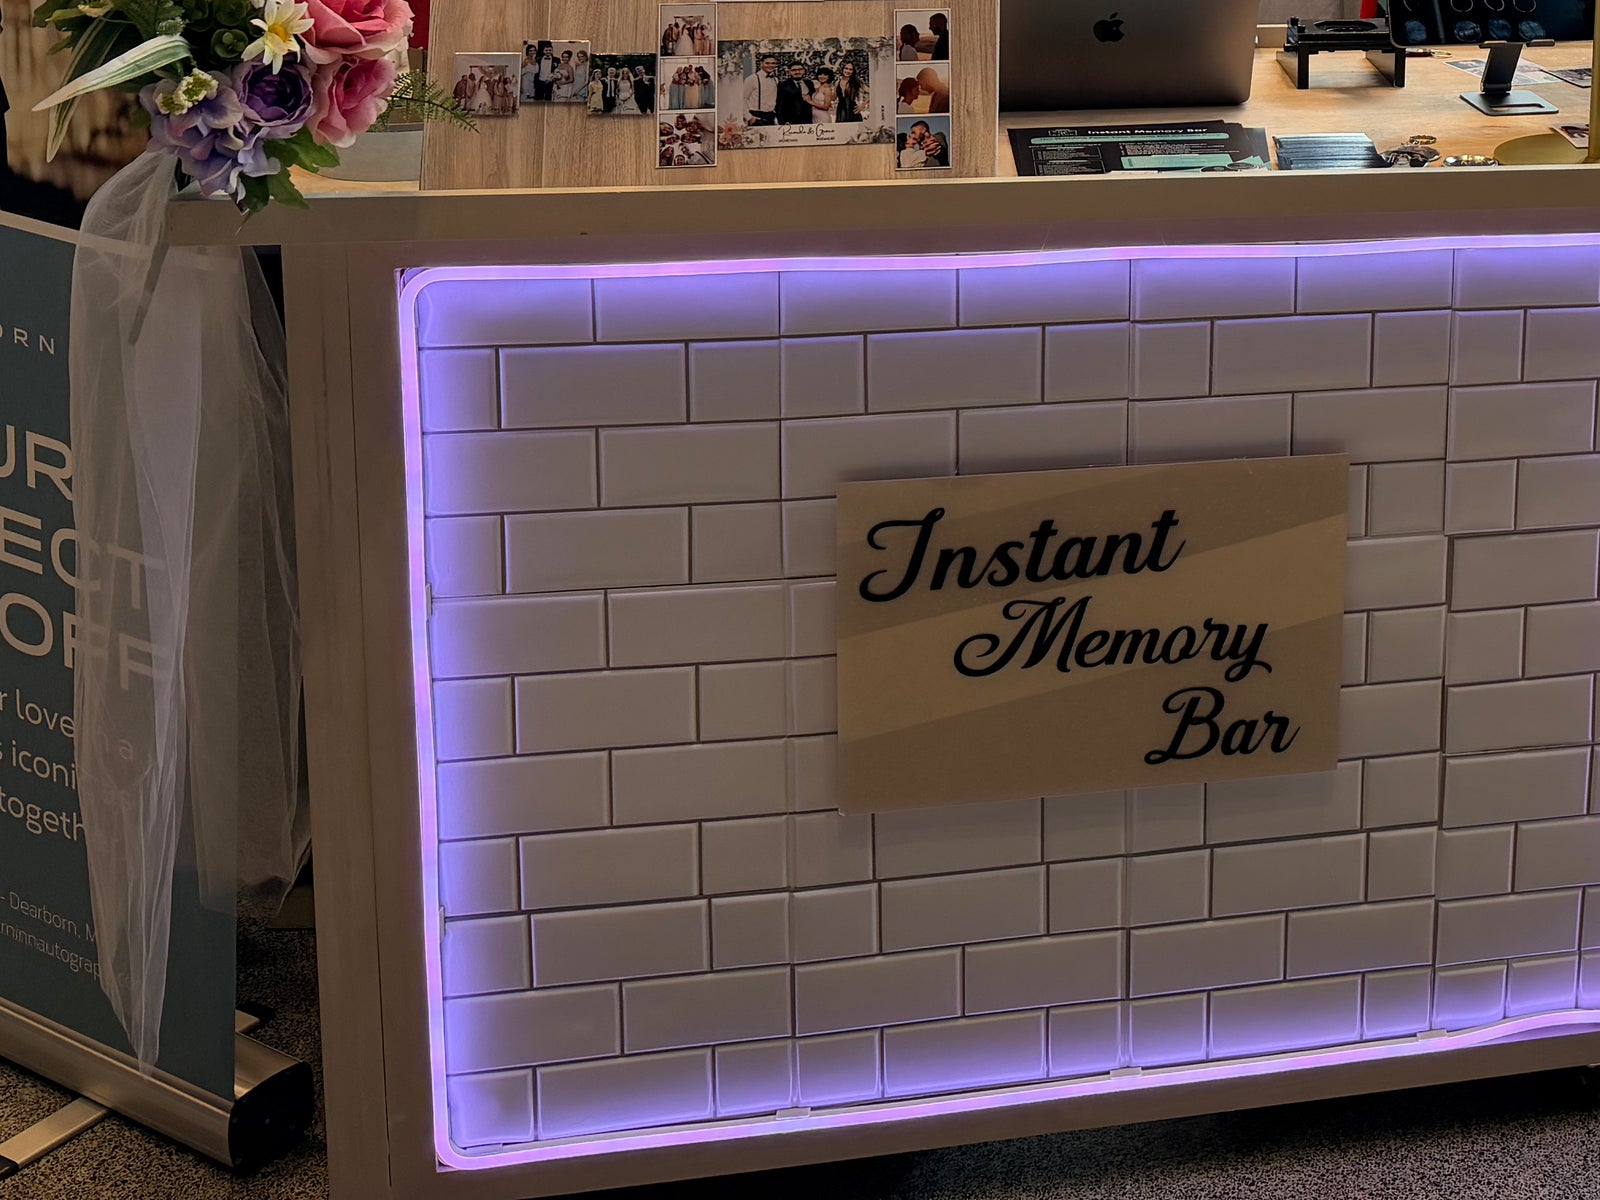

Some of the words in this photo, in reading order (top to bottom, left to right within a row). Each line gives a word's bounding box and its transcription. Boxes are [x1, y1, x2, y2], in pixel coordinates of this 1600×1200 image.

[0, 323, 56, 356] RN
[858, 507, 1187, 603] Instant
[952, 595, 1273, 683] Memory
[15, 688, 76, 739] love
[1143, 686, 1301, 766] Bar
[12, 739, 78, 791] iconi
[0, 786, 88, 842] togeth
[9, 891, 82, 939] Dearborn,
